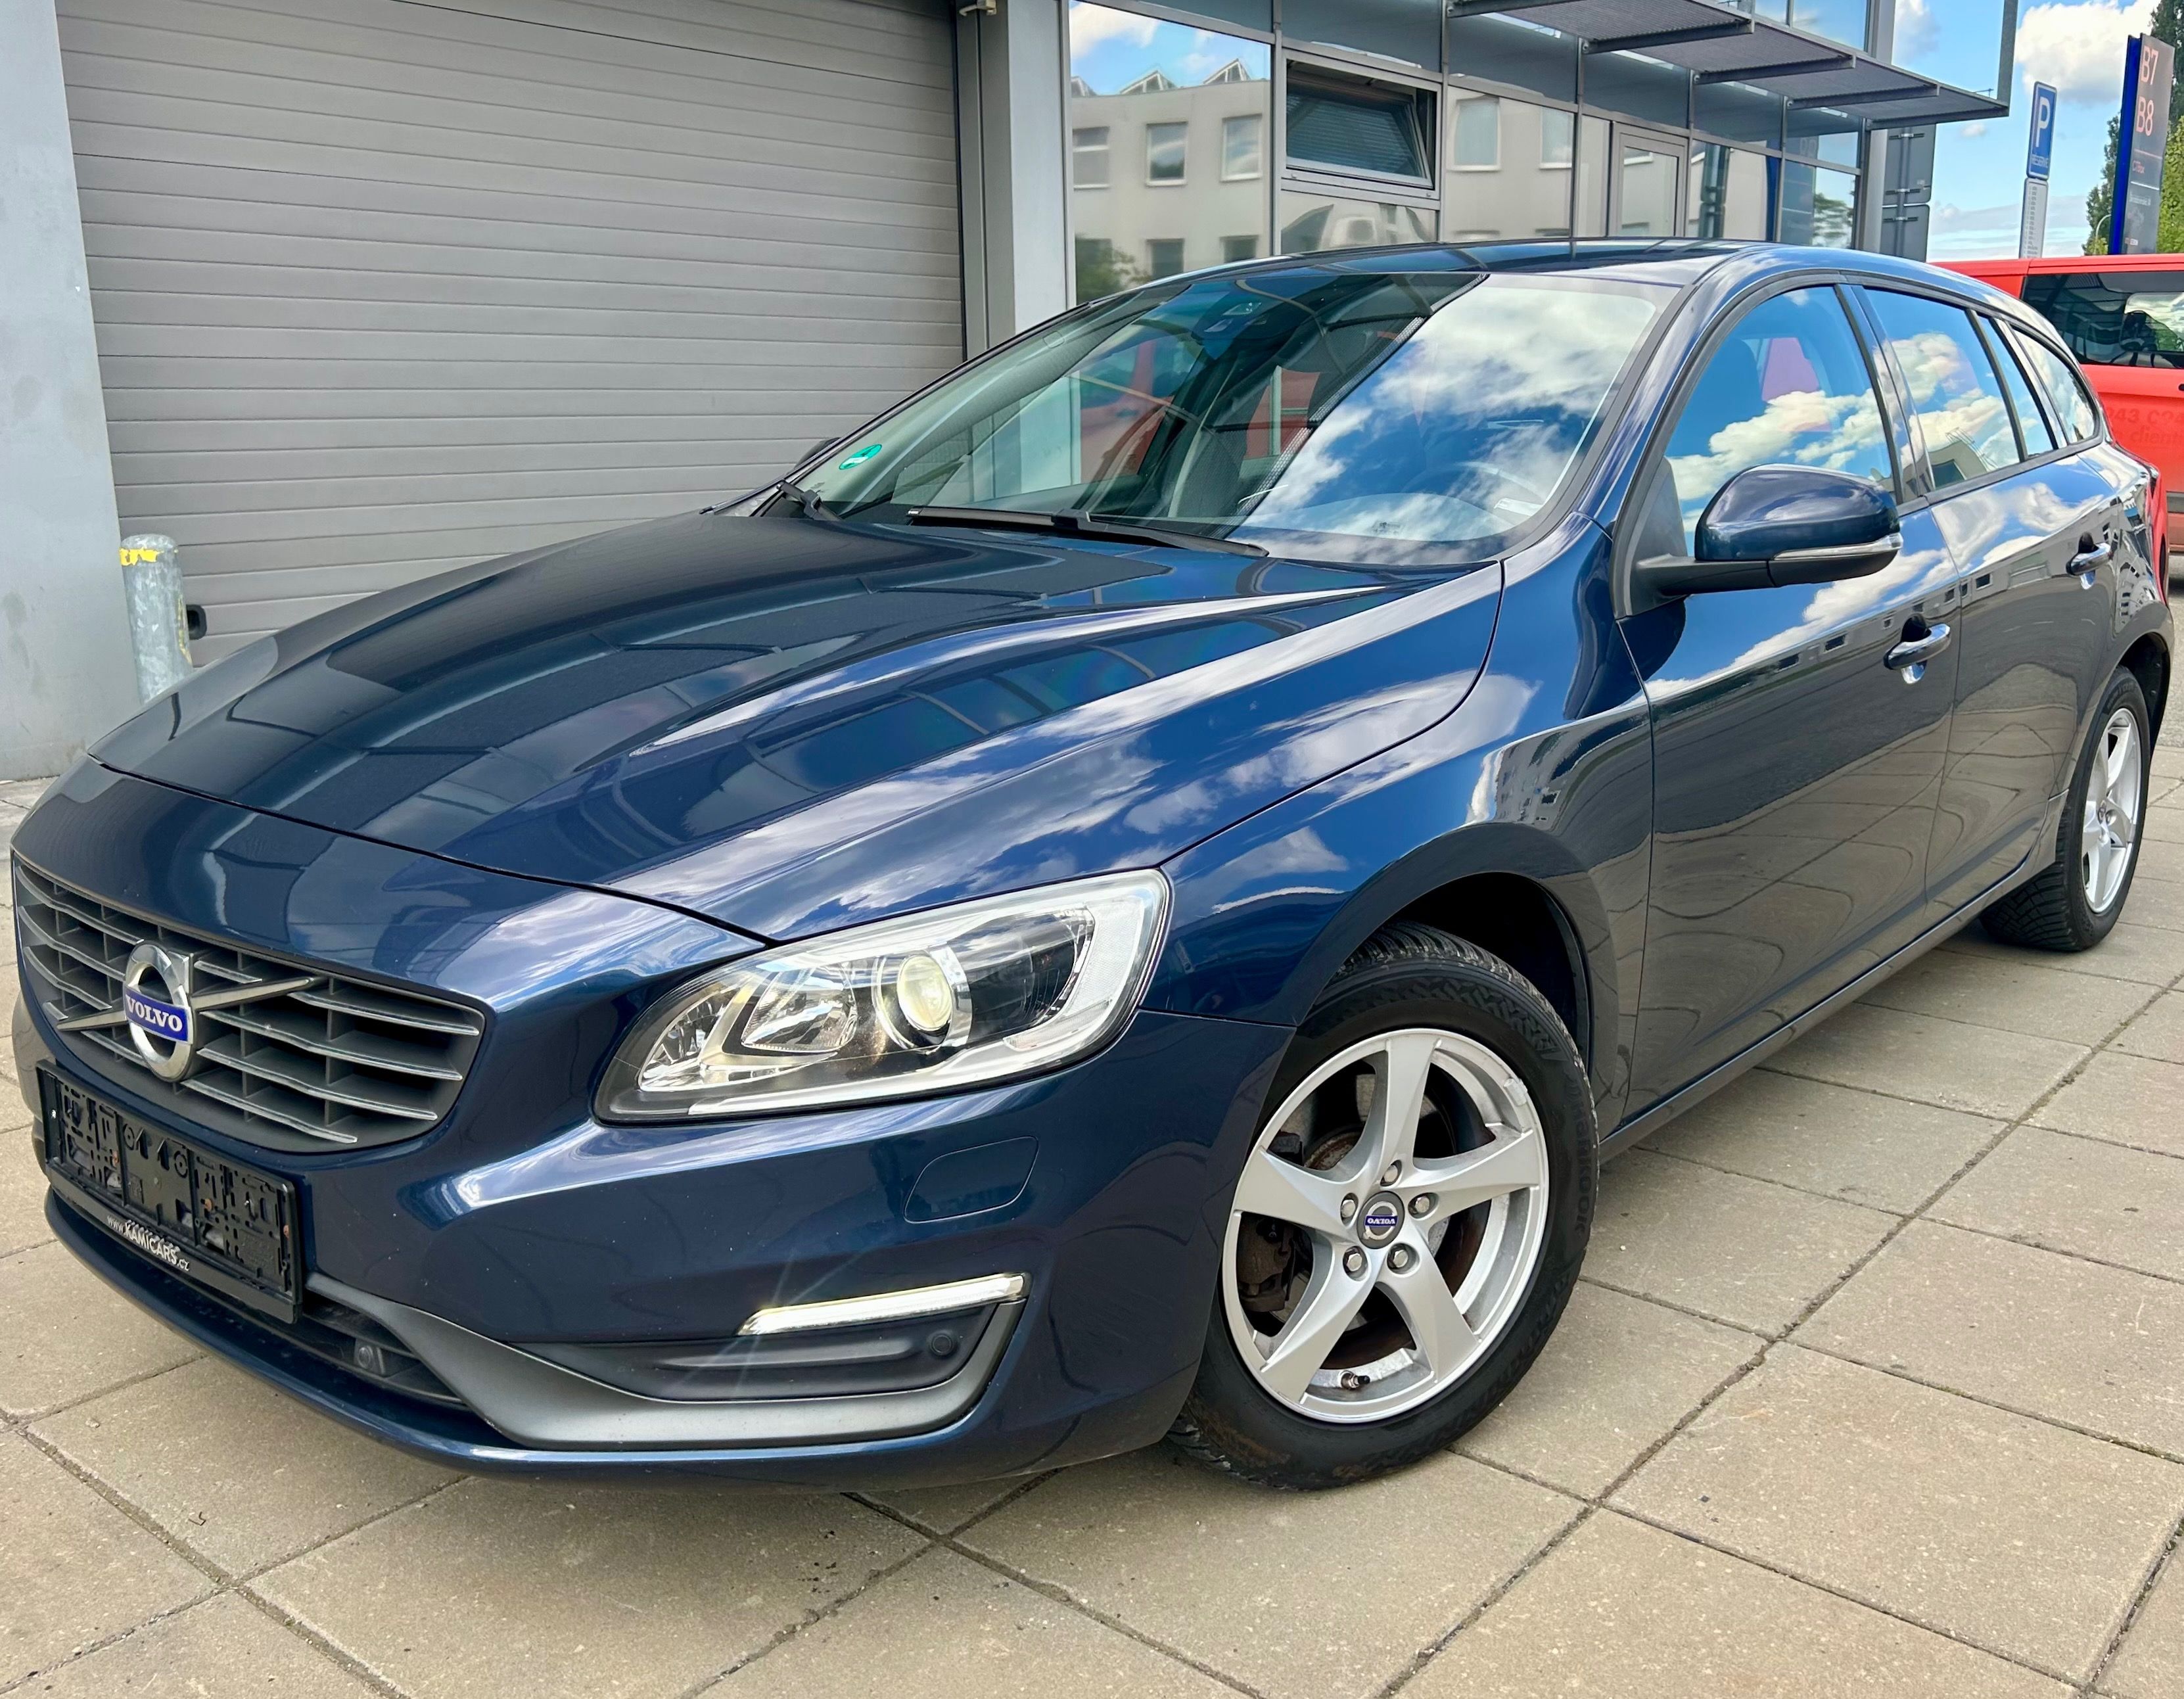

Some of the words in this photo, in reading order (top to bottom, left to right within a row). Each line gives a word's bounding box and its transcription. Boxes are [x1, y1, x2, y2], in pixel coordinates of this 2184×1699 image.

[2141, 45, 2159, 85] B7
[2035, 96, 2051, 147] P
[2136, 96, 2154, 137] B8
[125, 994, 183, 1032] VOLVO
